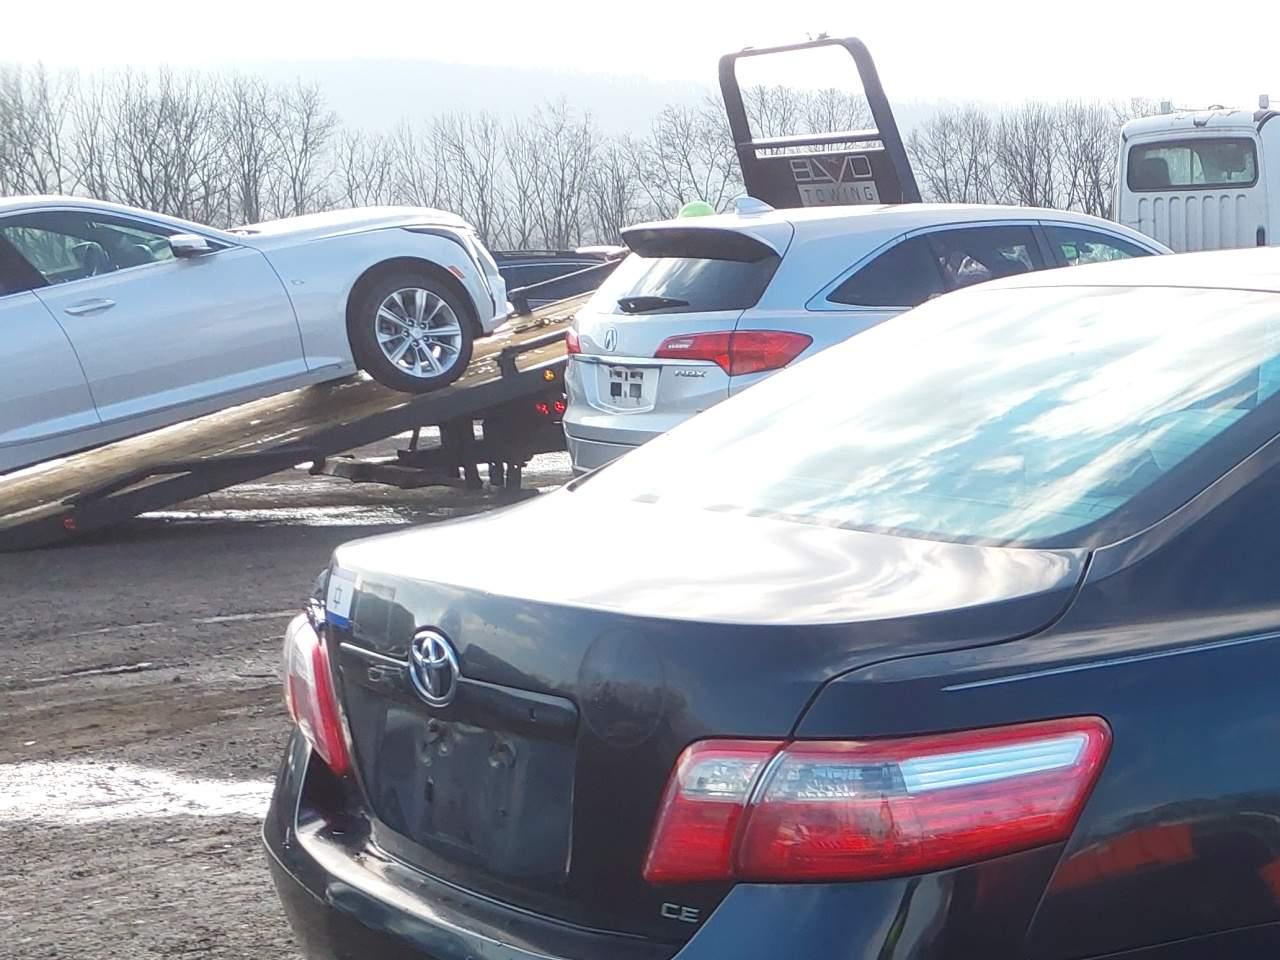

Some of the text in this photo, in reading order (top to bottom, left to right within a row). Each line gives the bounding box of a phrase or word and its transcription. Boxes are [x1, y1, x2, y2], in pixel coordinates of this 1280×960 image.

[790, 154, 872, 185] BLVD
[803, 186, 874, 203] TOWING
[661, 902, 699, 923] CE
